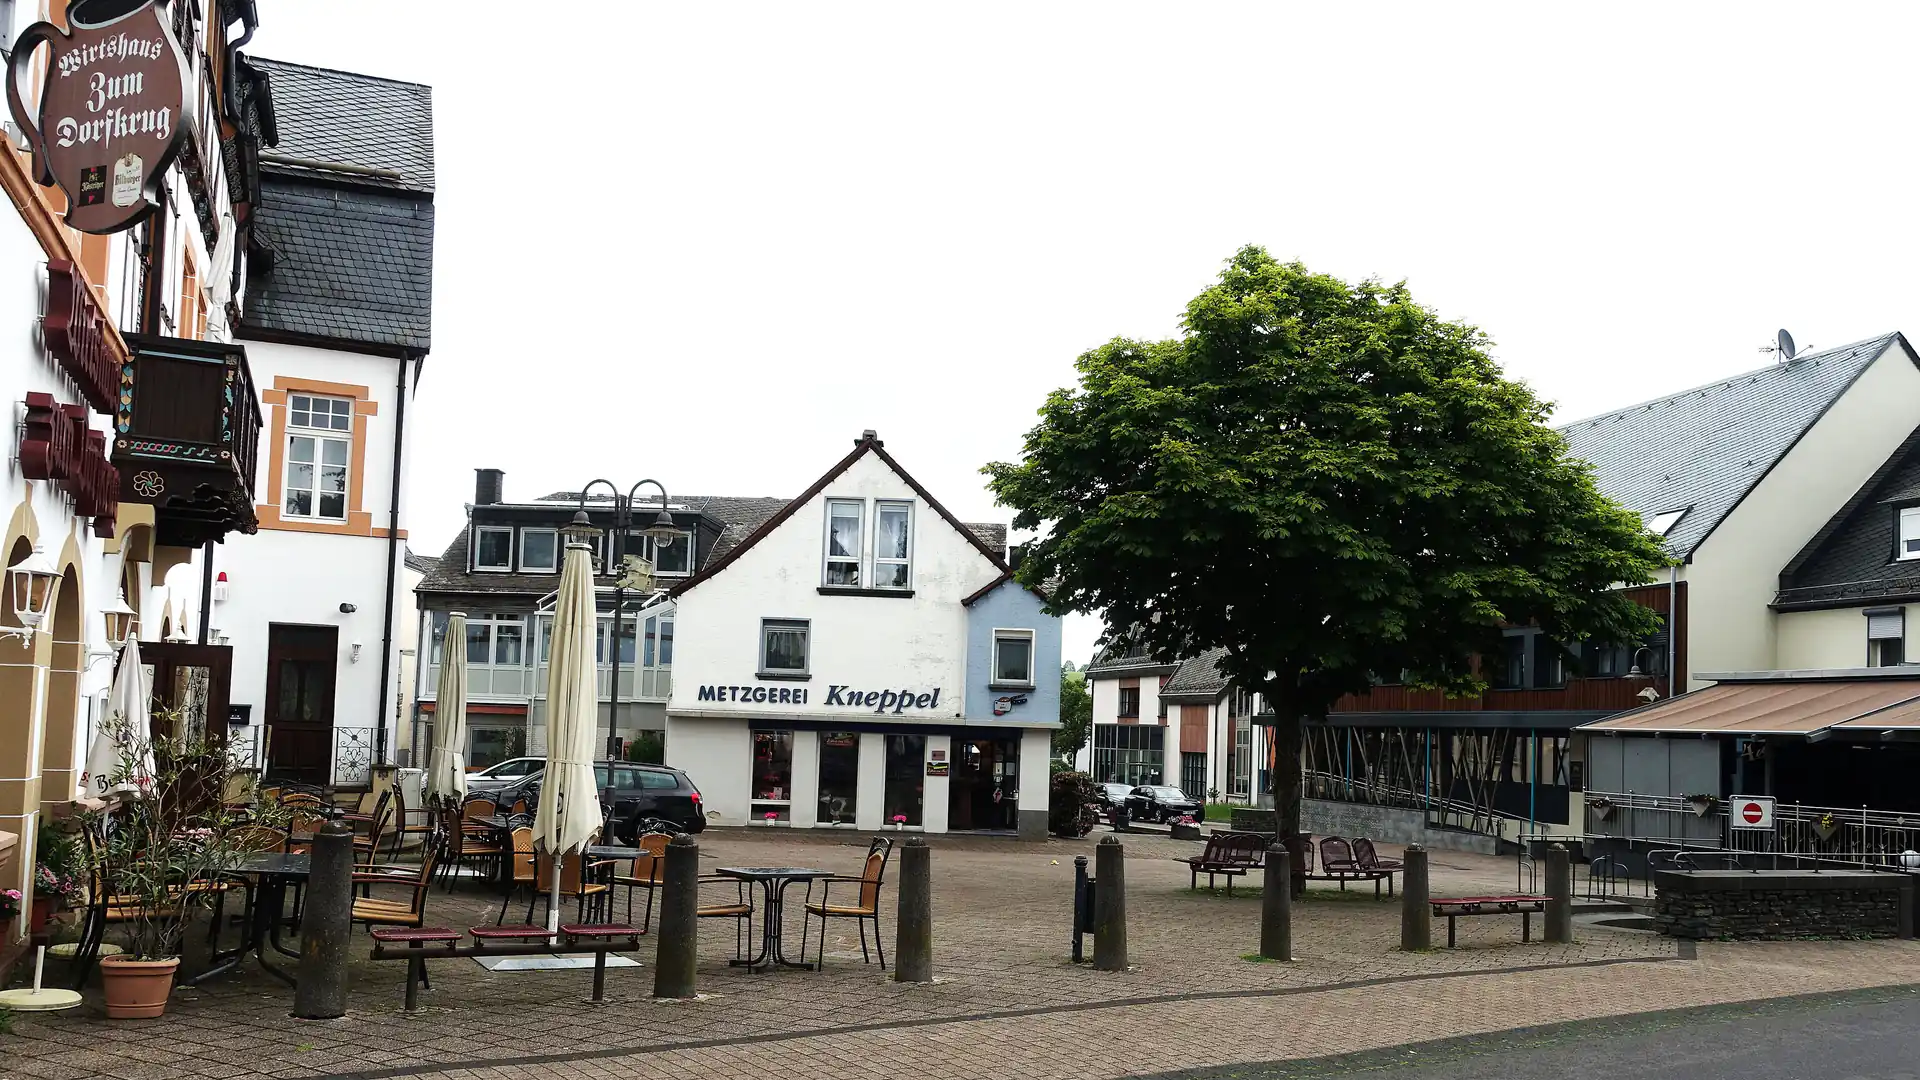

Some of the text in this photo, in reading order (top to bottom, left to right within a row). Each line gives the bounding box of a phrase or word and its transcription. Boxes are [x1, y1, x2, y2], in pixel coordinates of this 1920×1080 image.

[58, 32, 164, 79] Wirtshaus
[86, 71, 144, 112] Zum
[56, 106, 171, 149] Dorfkrug
[698, 685, 941, 714] METZGEREI Kneppel
